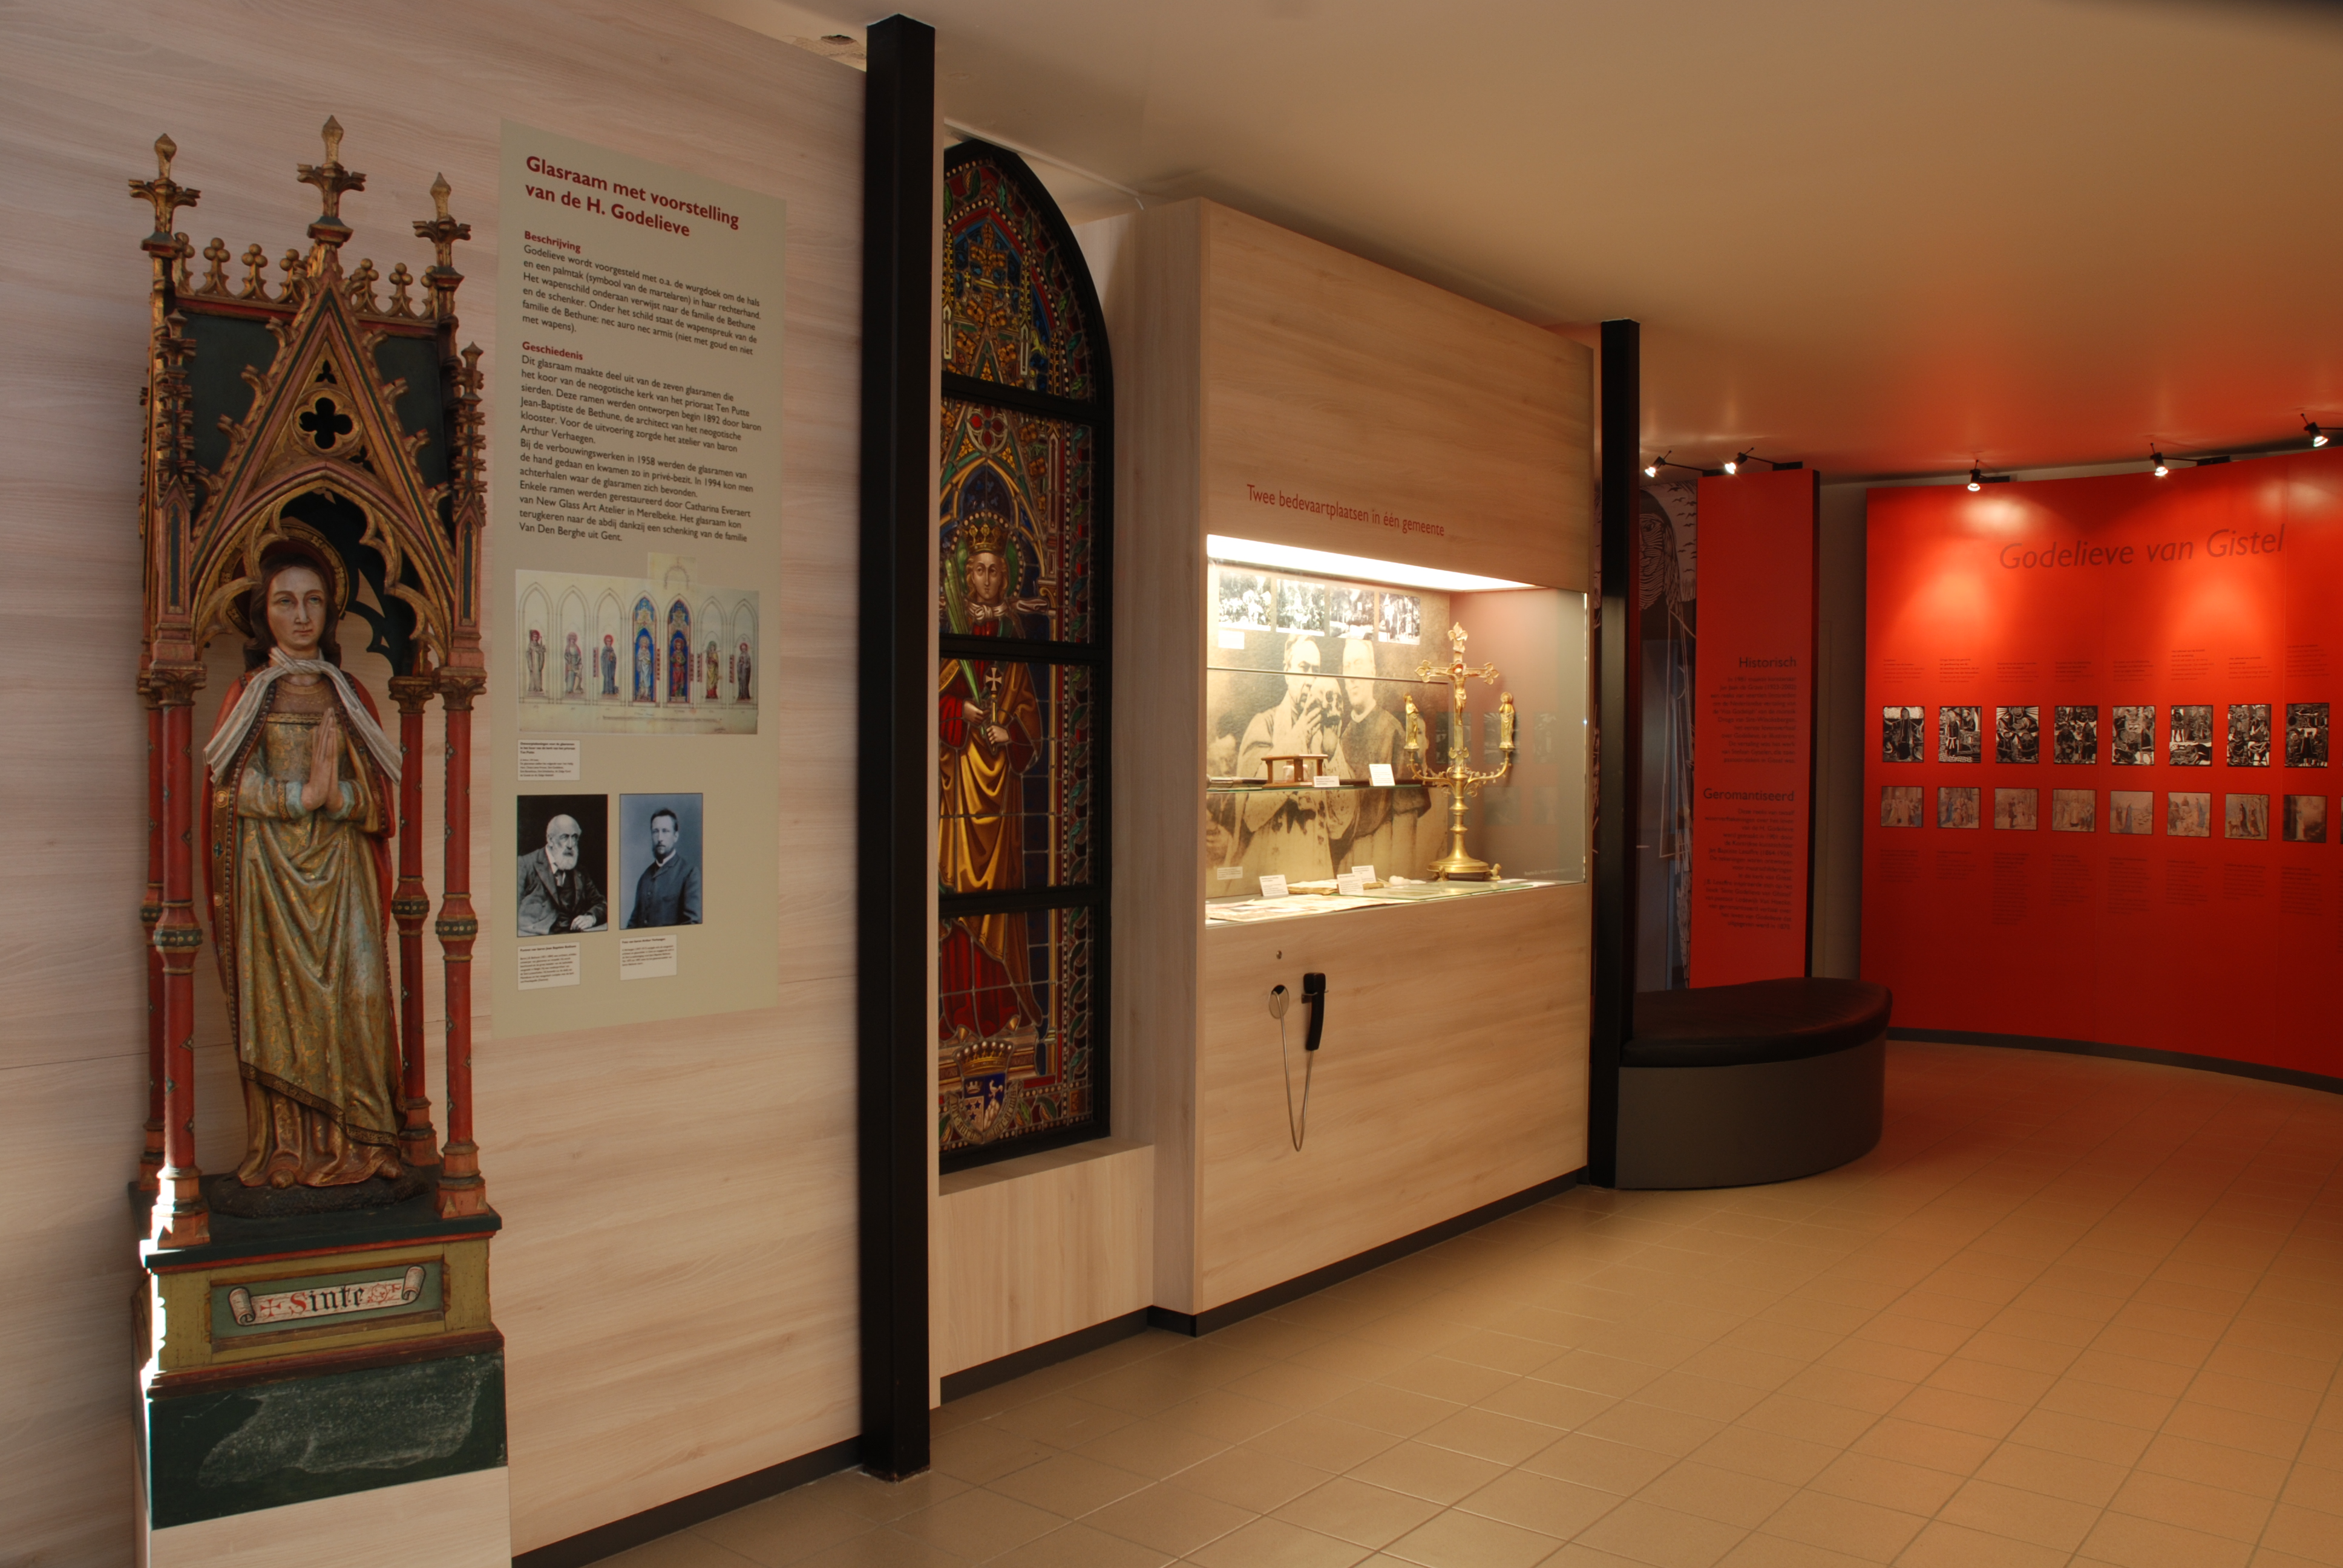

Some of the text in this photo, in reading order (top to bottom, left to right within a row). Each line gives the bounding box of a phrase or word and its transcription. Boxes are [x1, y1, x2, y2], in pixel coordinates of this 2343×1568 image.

[525, 185, 690, 237] van de H. Godelieve
[526, 155, 739, 230] Glasraam met voorstelling
[524, 230, 581, 255] Beschrijving
[523, 244, 565, 262] Godelieve
[568, 257, 593, 268] wordt
[595, 263, 640, 279] voorgesteld
[642, 274, 657, 283] met
[659, 278, 672, 286] o.a.
[674, 279, 684, 289] de
[686, 284, 721, 298] wurgdoek
[736, 295, 745, 304] de
[747, 296, 760, 307] hals
[536, 263, 551, 272] een
[552, 267, 583, 279] palmtak
[586, 272, 621, 287] (symbool
[623, 283, 636, 291] van
[638, 284, 647, 294] de
[649, 289, 691, 305] martelaren)
[693, 297, 700, 305] in
[701, 298, 716, 309] haar
[719, 305, 761, 319] rechterhand.
[523, 272, 756, 331] Het wapenschild onderaan verwijst naar de familie de Bethune
[522, 316, 577, 334] met wapens).
[522, 341, 583, 361] Geschiedenis
[521, 368, 535, 379] het
[537, 371, 558, 383] koor
[560, 377, 574, 386] van
[576, 379, 586, 388] de
[588, 383, 635, 397] neogotische
[637, 389, 654, 400] kerk
[671, 395, 683, 405] het
[685, 399, 713, 411] prioraat
[716, 403, 729, 413] Ten
[732, 406, 750, 417] Putte
[522, 354, 536, 366] Dit
[537, 359, 572, 372] glasraam
[575, 367, 603, 377] maakte
[606, 370, 622, 381] deel
[624, 374, 635, 384] uit
[651, 379, 661, 388] de
[663, 383, 684, 392] zeven
[686, 385, 721, 399] glasramen
[723, 392, 734, 402] die
[520, 396, 573, 413] Jean-Baptiste
[575, 406, 586, 416] de
[588, 407, 622, 422] Bethune,
[624, 414, 634, 423] de
[636, 417, 669, 429] architect
[686, 423, 698, 434] het
[700, 428, 741, 441] neogotische
[521, 384, 761, 431] sierden. Deze ramen werden ontworpen begin 1892 door baron
[520, 410, 557, 425] klooster.
[560, 416, 581, 428] Voor
[583, 420, 593, 430] de
[595, 423, 634, 439] uitvoering
[636, 431, 662, 442] zorgde
[664, 433, 677, 443] het
[678, 437, 701, 446] atelier
[717, 442, 738, 452] baron
[520, 425, 595, 445] Arthur Verhaegen.
[520, 438, 531, 451] Bij
[533, 440, 543, 450] de
[546, 444, 625, 462] verbouwingswerken
[628, 454, 634, 463] in
[638, 455, 655, 466] 1958
[657, 460, 686, 470] werden
[687, 463, 696, 472] de
[698, 465, 733, 477] glasramen
[520, 467, 698, 498] achterhalen waar de glasramen zich bevonden.
[520, 480, 751, 518] Enkele ramen werden gerestaureerd door Catharina Everaert
[519, 510, 565, 521] terugkeren
[586, 516, 597, 525] de
[598, 518, 617, 530] abdij
[619, 520, 645, 533] dankzij
[663, 525, 698, 539] schenking
[714, 531, 723, 540] de
[725, 532, 747, 542] familie
[536, 496, 556, 506] New
[559, 498, 580, 510] Glass
[582, 501, 597, 512] Art
[598, 504, 625, 515] Atelier
[637, 508, 678, 521] Merelbeke.
[680, 514, 694, 523] Het
[695, 516, 726, 527] glasraam
[728, 520, 741, 529] kon
[1247, 484, 1444, 537] Twee bedevaartplaatsen in één gemeente
[519, 521, 623, 541] Van Den Berghe uit Gent.
[1999, 524, 2285, 569] Godelieve van Gistel
[1739, 656, 1797, 668] Historisch
[1703, 788, 1794, 802] Geromantiseerd
[289, 1285, 365, 1316] Sinte
